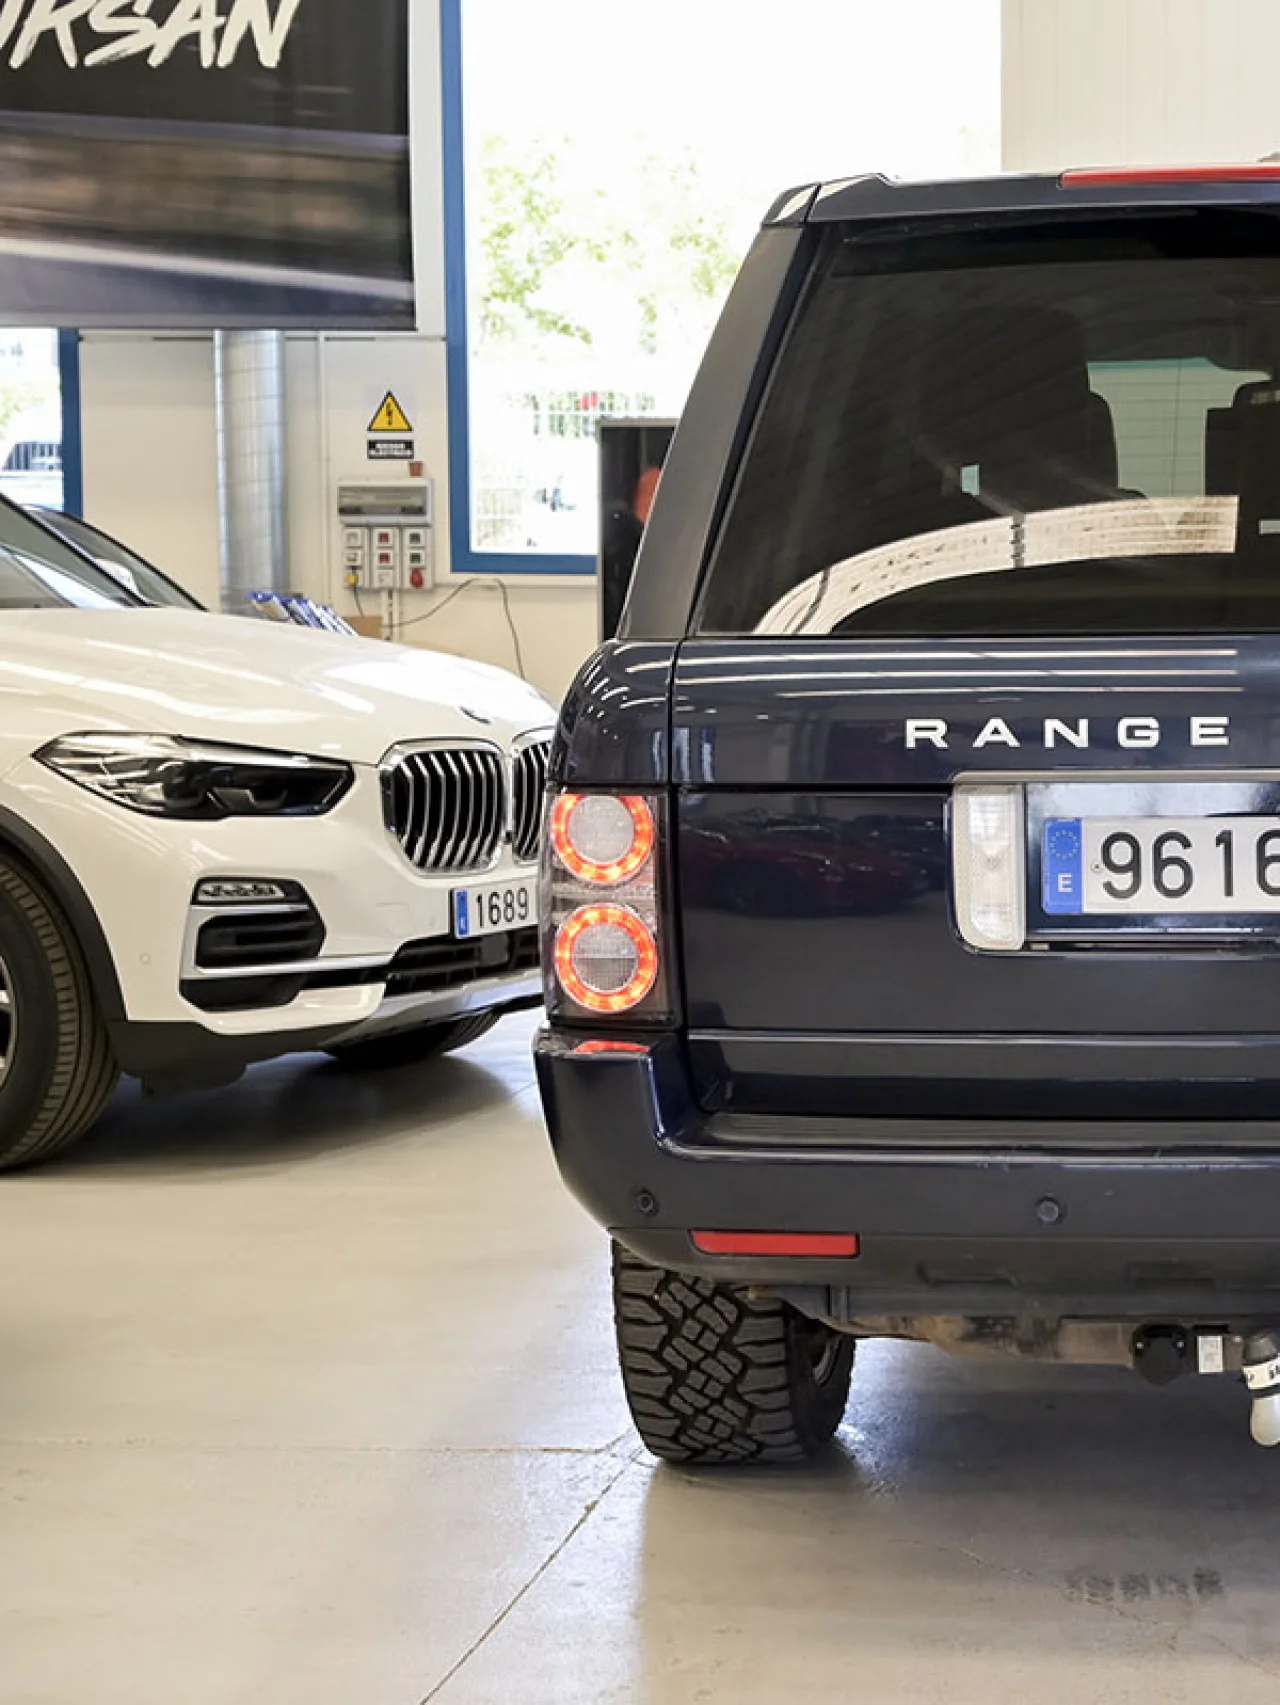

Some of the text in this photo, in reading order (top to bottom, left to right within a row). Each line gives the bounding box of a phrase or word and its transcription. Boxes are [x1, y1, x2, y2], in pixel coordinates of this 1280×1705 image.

[905, 716, 1230, 749] RANGE
[1057, 873, 1072, 893] E
[476, 887, 528, 927] 1689
